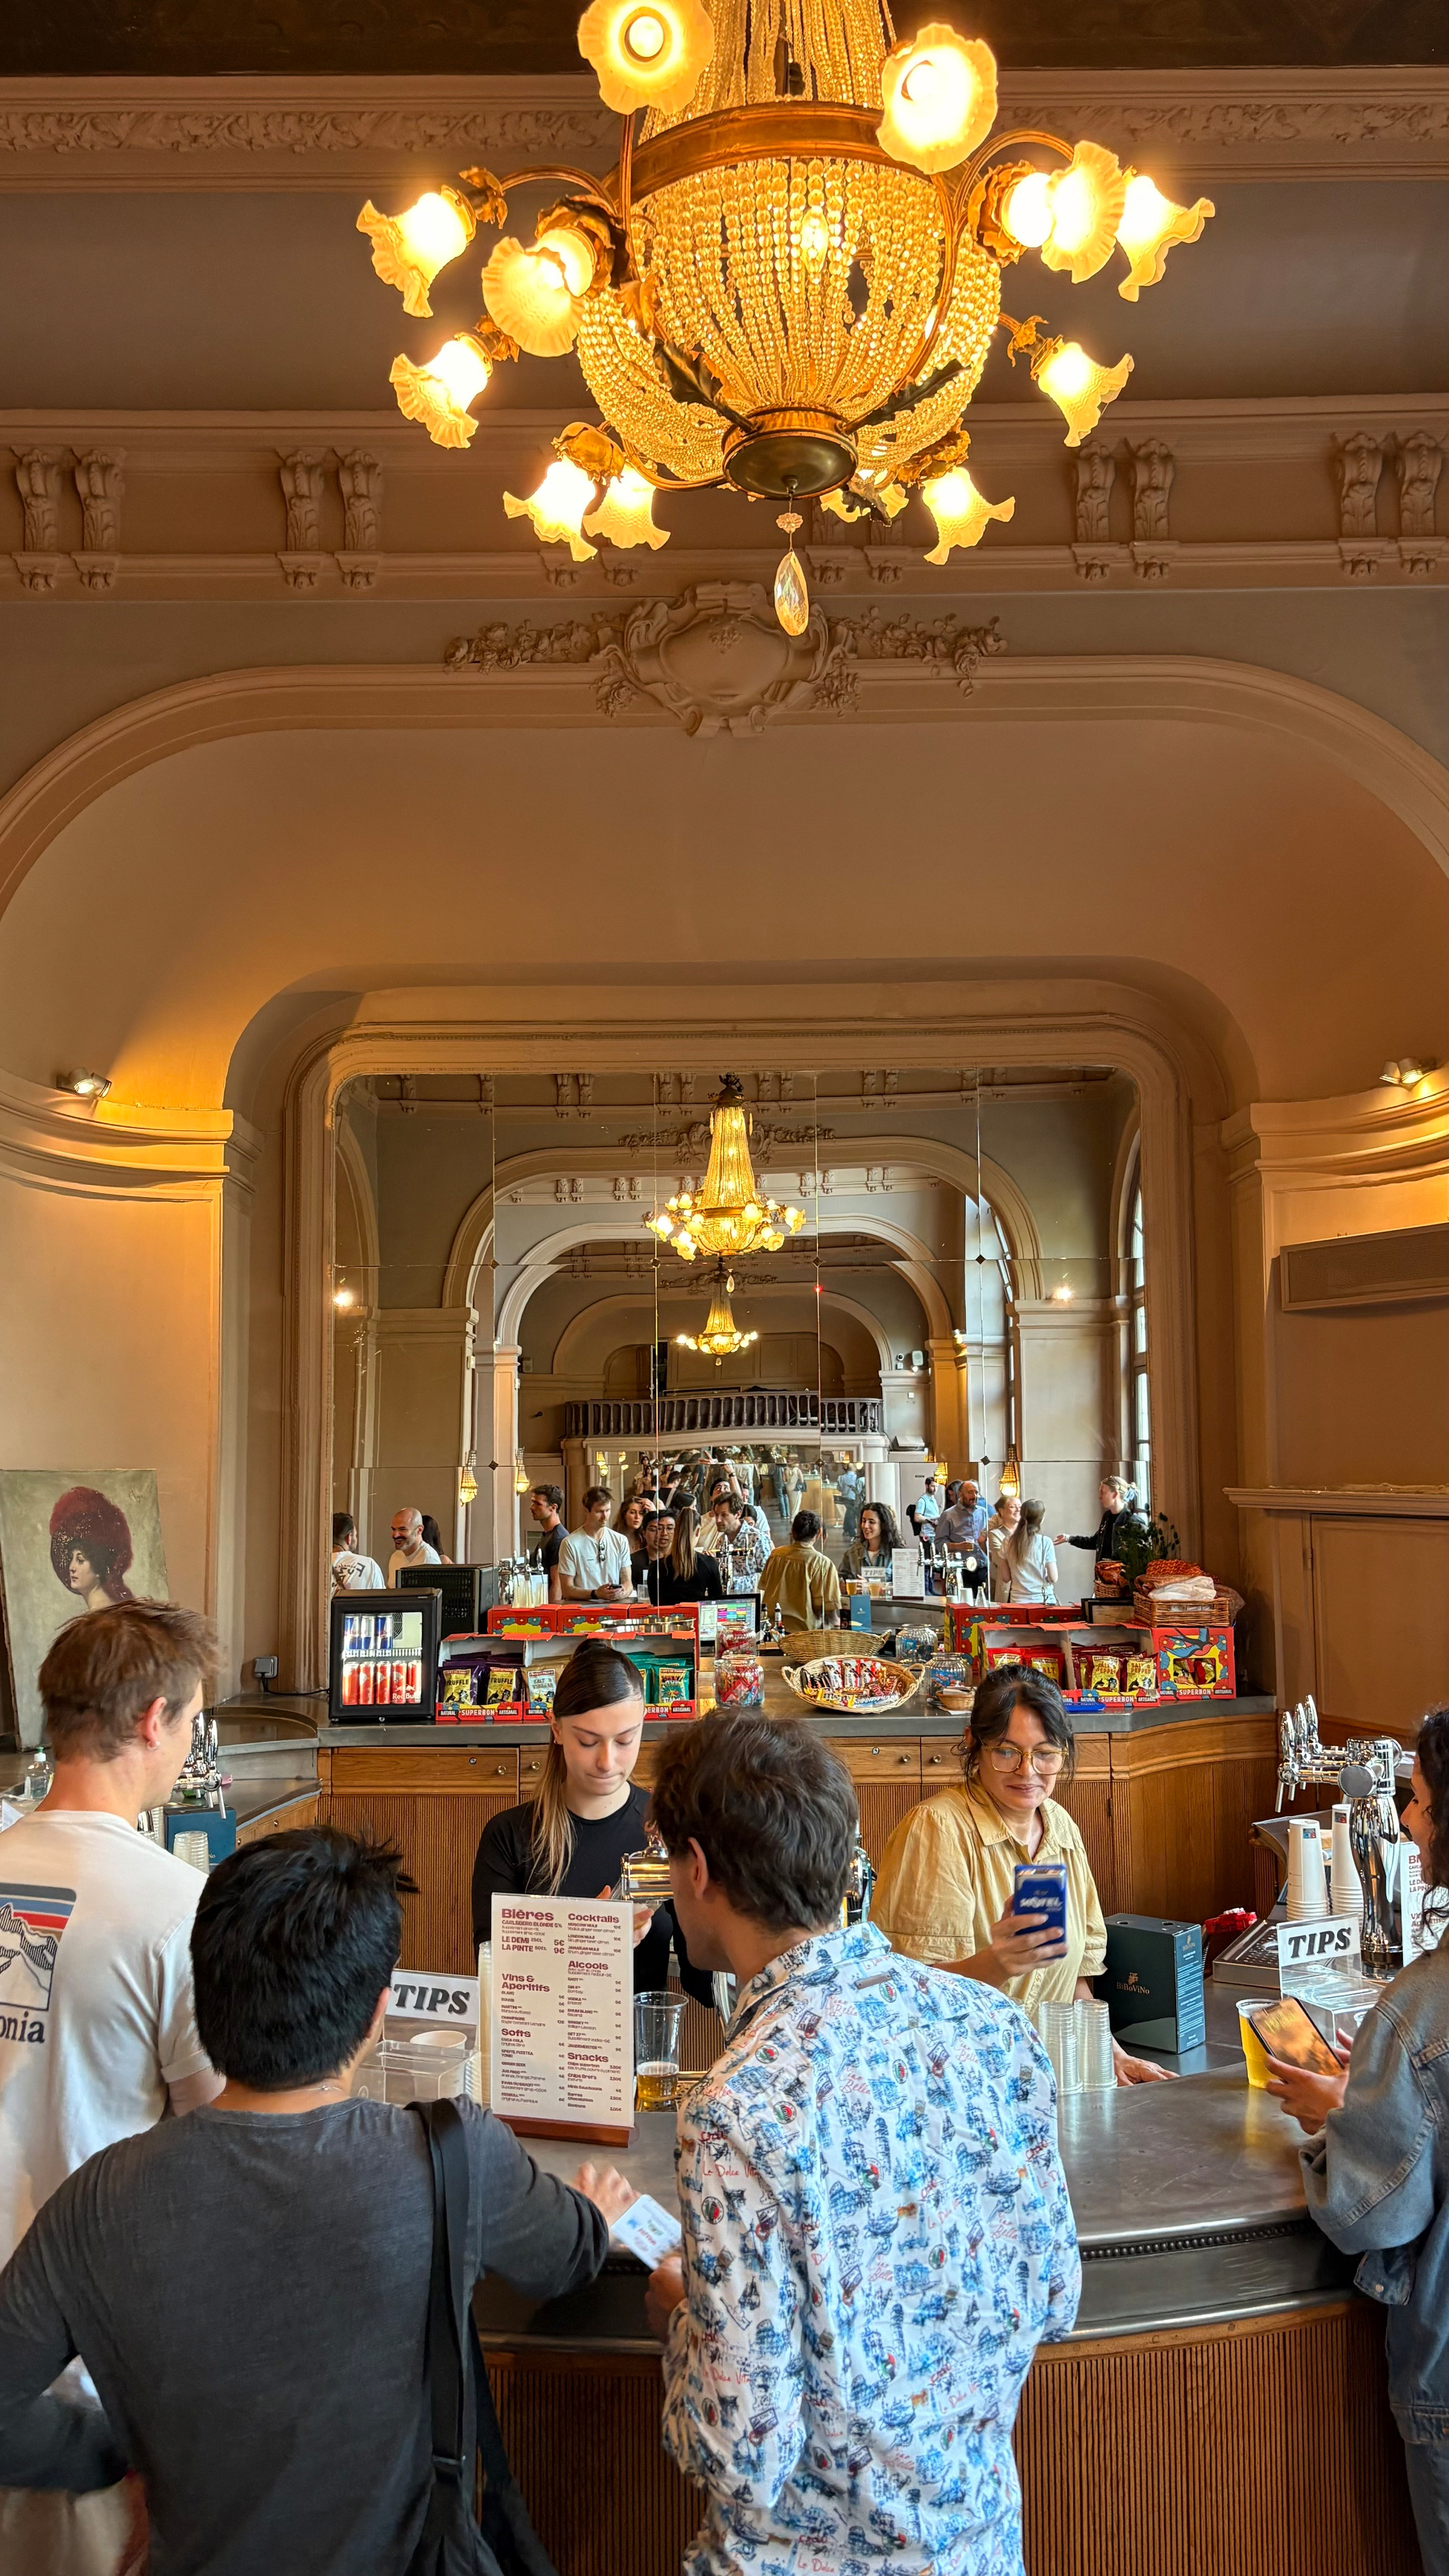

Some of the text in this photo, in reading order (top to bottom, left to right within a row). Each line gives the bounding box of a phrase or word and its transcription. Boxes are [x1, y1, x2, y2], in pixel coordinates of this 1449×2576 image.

[502, 1908, 554, 1921] Bières
[568, 1913, 619, 1923] Cocktails
[1288, 1927, 1352, 1959] TIPS
[568, 1961, 608, 1970] Alcools
[502, 1973, 525, 1982] Vins
[1116, 1982, 1150, 1995] BiBoViNo
[394, 1984, 470, 2015] TIPS
[501, 2028, 531, 2037] Softs
[568, 2052, 609, 2063] Snacks
[715, 2164, 739, 2178] Dolce
